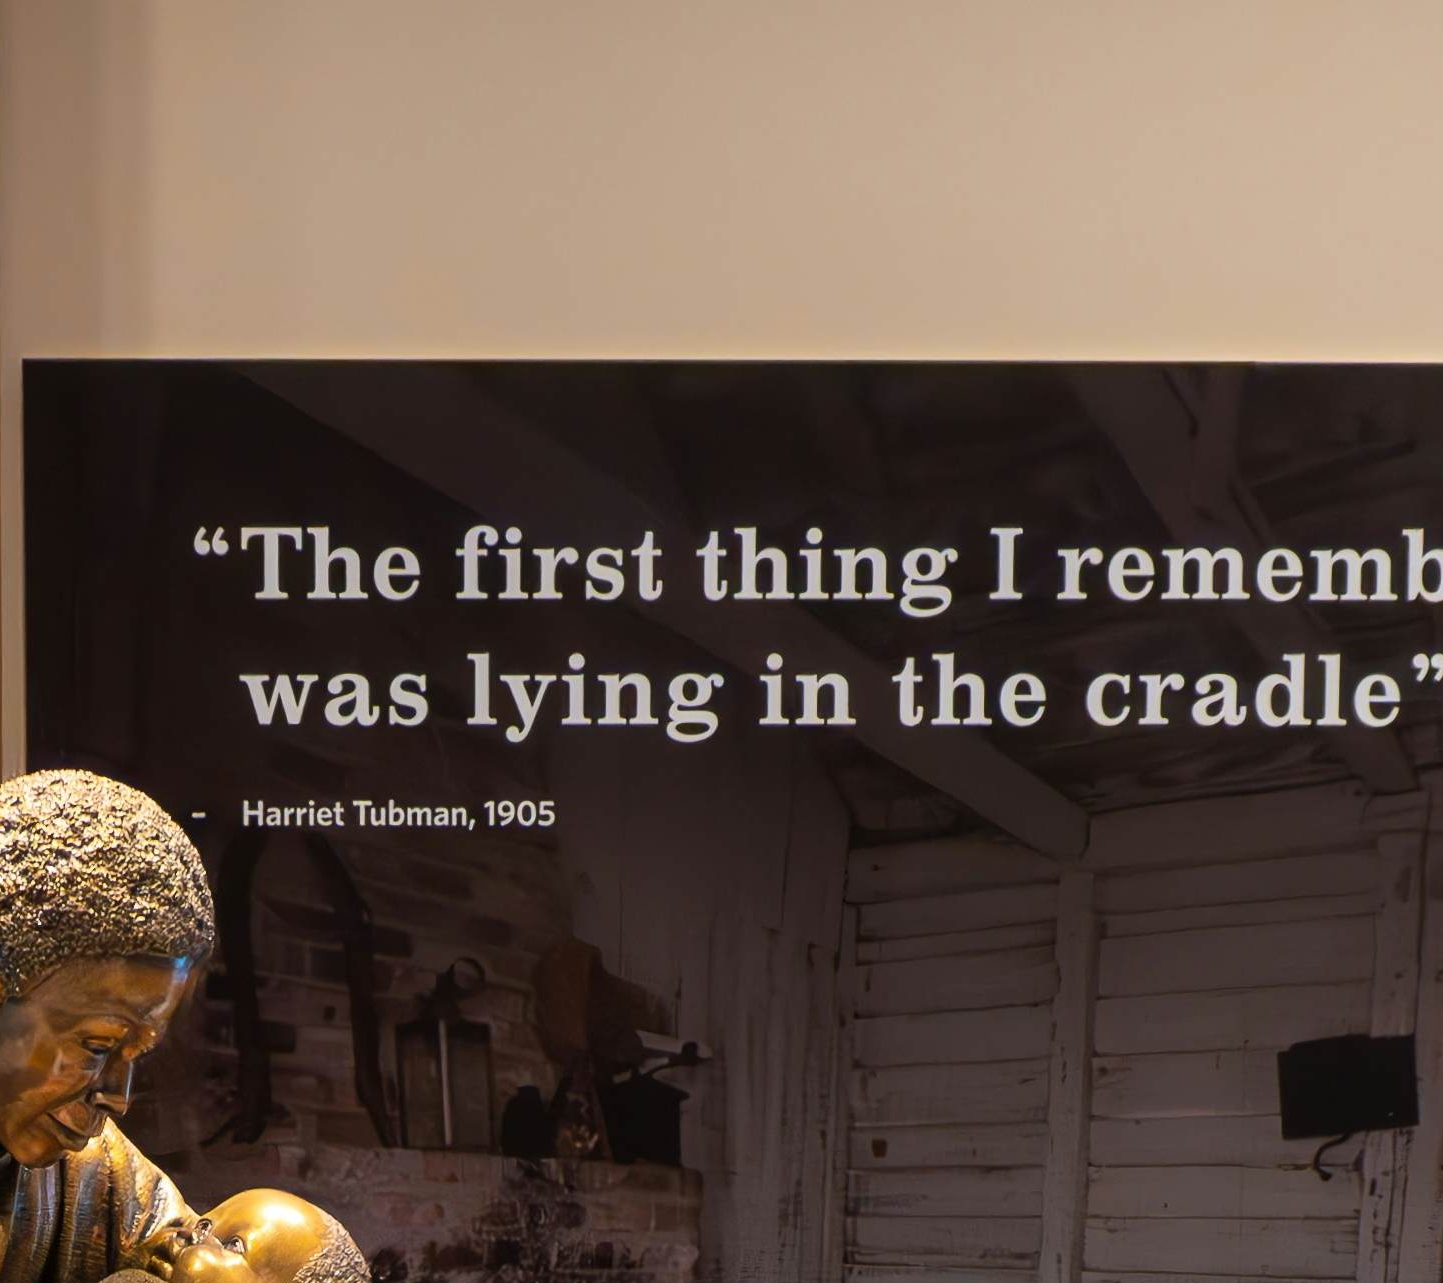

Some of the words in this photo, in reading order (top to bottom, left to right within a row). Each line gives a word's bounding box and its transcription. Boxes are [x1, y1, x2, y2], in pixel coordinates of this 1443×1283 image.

[193, 526, 421, 601] “The
[455, 524, 663, 602] first
[695, 526, 959, 618] thing
[988, 527, 1024, 600] I
[238, 672, 429, 727] was
[466, 652, 725, 743] lying
[758, 652, 857, 726] in
[891, 652, 1047, 727] the
[242, 799, 345, 827] Harriet
[352, 798, 476, 831] Tubman,
[483, 800, 556, 827] 1905
